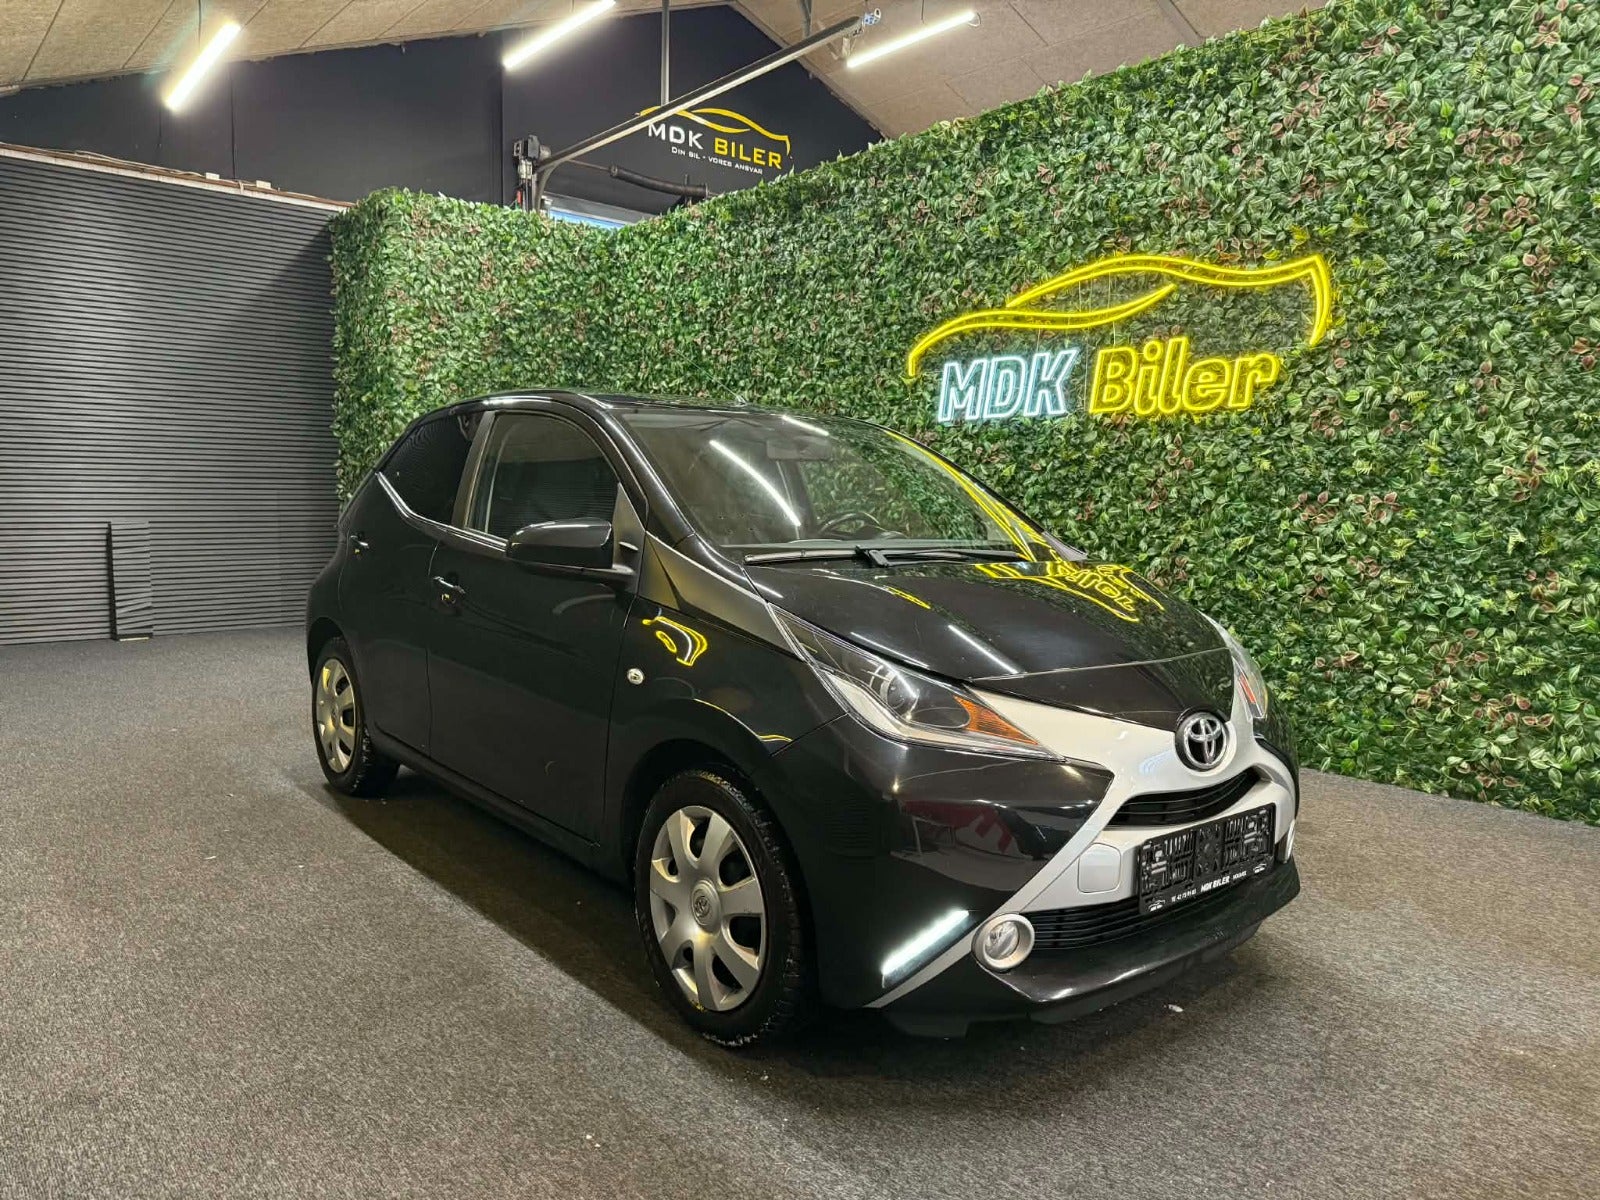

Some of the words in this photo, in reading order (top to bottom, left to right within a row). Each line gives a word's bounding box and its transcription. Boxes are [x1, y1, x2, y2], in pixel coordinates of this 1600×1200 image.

[648, 123, 704, 150] MDK
[713, 137, 782, 170] BILER
[708, 156, 732, 168] VORES
[734, 163, 763, 175] ANSVAR
[938, 347, 1079, 422] MDK
[1088, 336, 1281, 416] Biler
